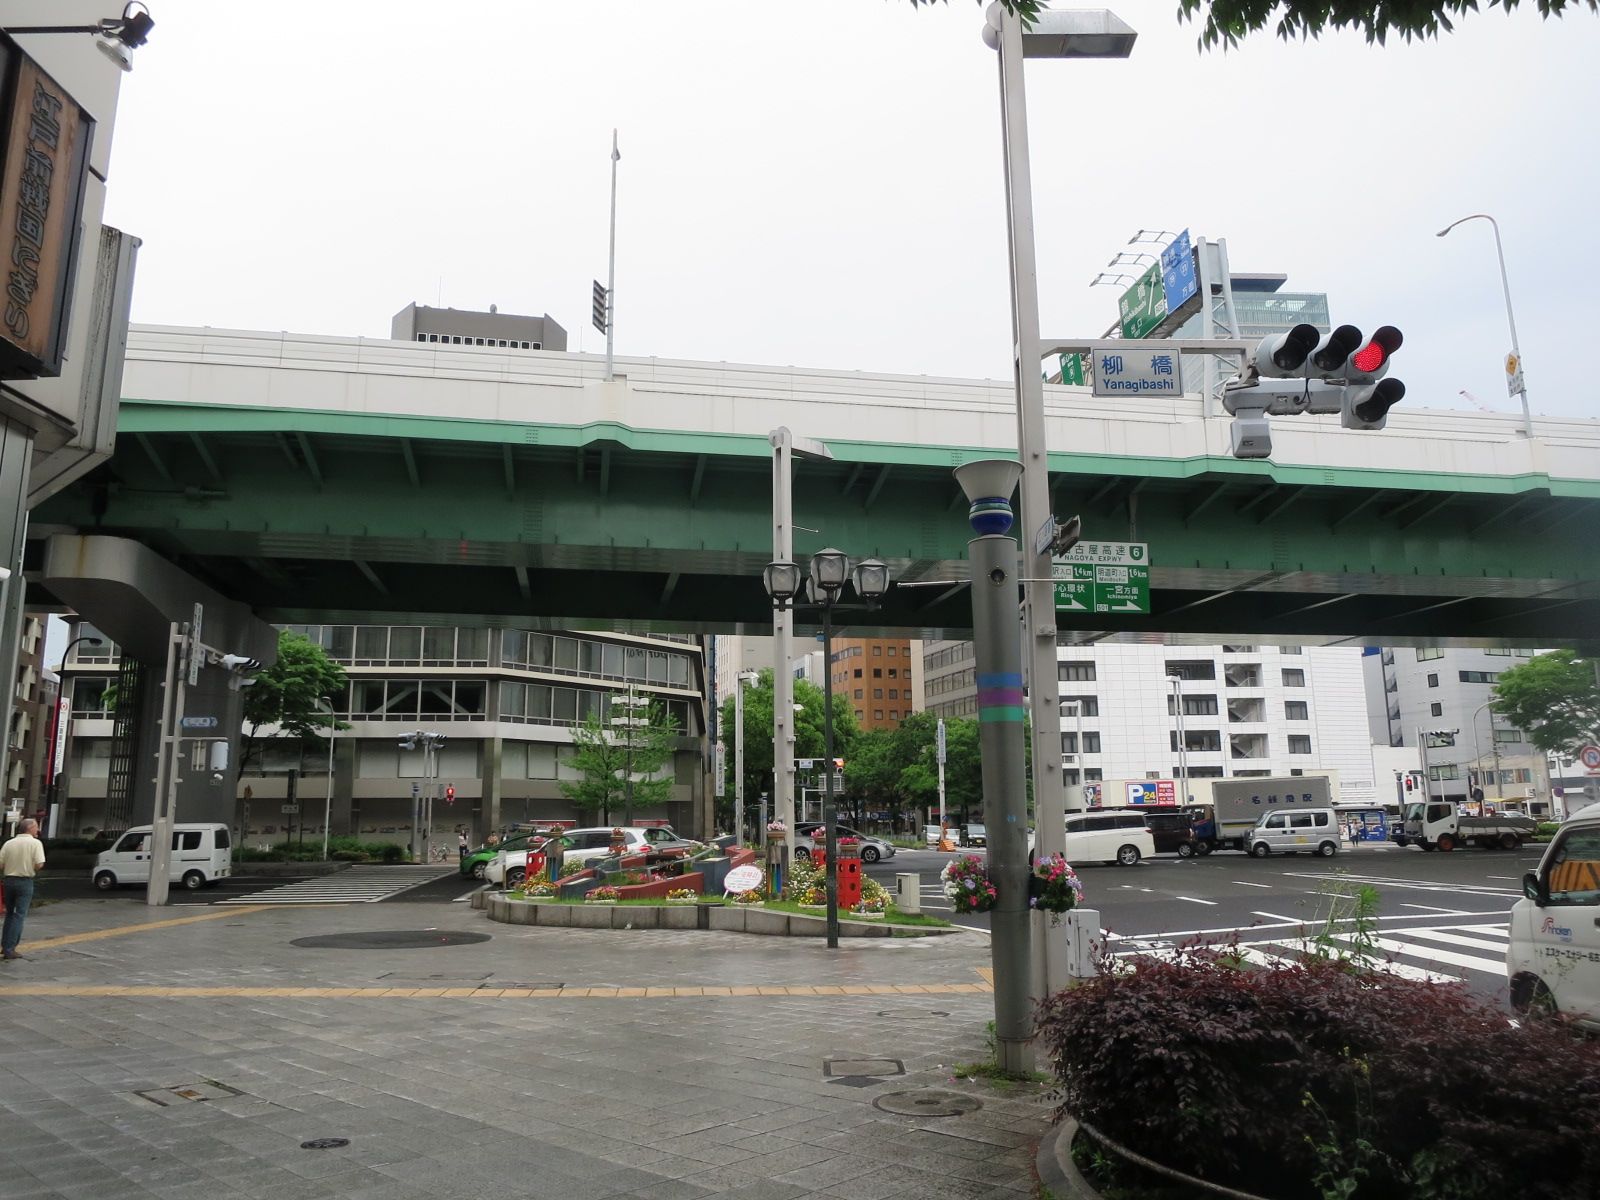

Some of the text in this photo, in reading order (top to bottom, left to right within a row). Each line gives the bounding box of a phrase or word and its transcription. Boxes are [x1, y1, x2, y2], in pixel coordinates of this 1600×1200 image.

[1103, 379, 1174, 392] Yanagibashi
[1105, 585, 1139, 595] 一宮方面
[1127, 784, 1144, 803] P
[1144, 792, 1156, 800] 24
